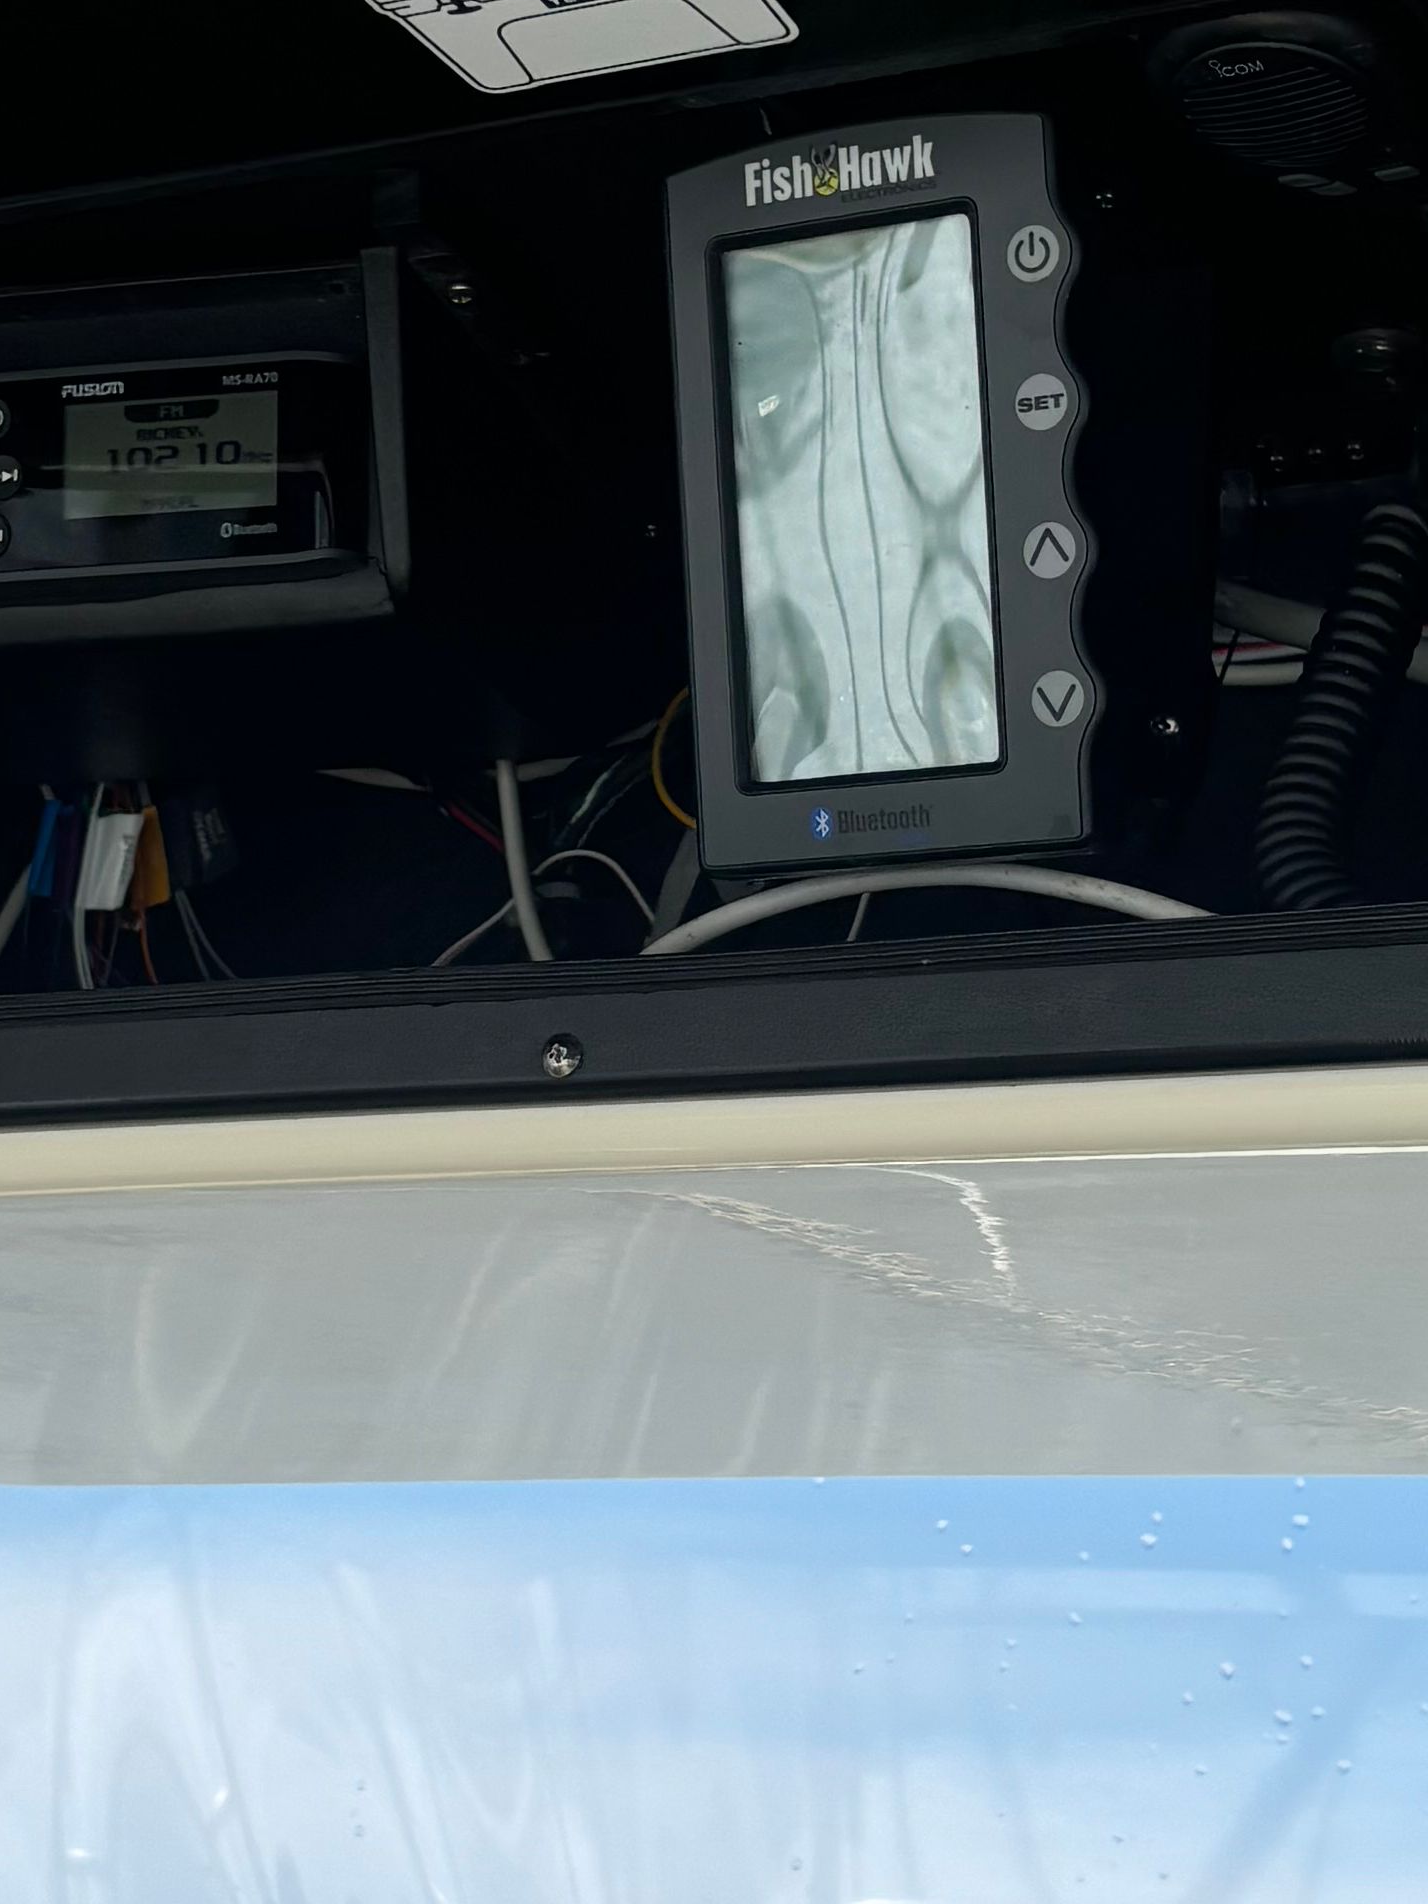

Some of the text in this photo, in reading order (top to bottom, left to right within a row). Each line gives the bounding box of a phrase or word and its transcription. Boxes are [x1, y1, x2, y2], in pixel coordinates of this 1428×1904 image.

[744, 134, 936, 208] Fish Hawk
[841, 179, 937, 204] ELECTRONICS
[61, 380, 125, 399] FUSION
[159, 404, 186, 419] FM
[1017, 392, 1065, 415] SET
[838, 803, 931, 834] Bluetooth
